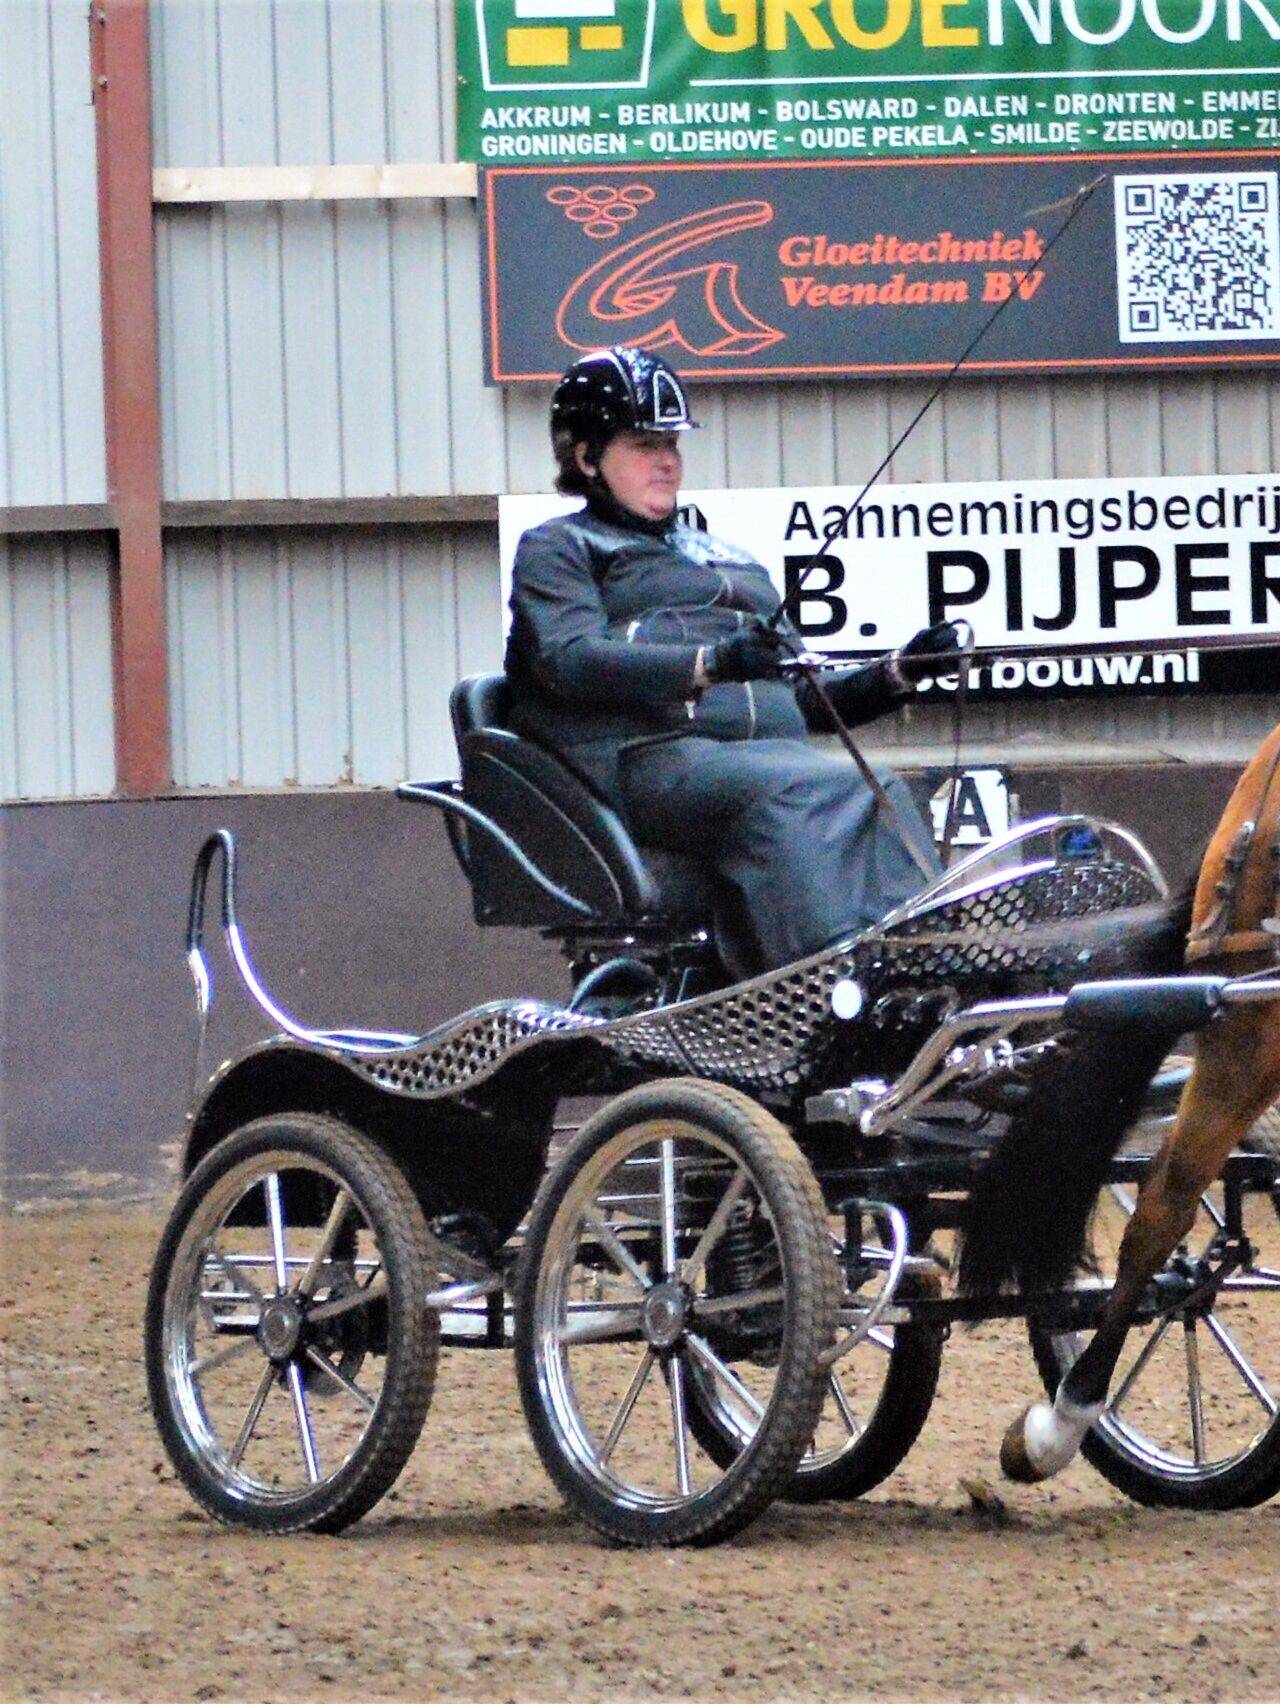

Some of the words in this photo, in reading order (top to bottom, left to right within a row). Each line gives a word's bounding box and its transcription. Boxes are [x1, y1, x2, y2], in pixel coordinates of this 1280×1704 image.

[481, 105, 591, 129] AKKRUM
[618, 102, 750, 126] BERLIKUM
[776, 97, 918, 122] BOLSWARD
[944, 95, 1028, 118] DALEN
[1055, 92, 1175, 115] DRONTEN
[480, 133, 627, 157] GRONINGEN
[650, 129, 778, 153] OLDEHOVE
[801, 127, 866, 149] OUDE
[872, 124, 969, 148] PEKELA
[990, 121, 1080, 144] SMILDE
[1102, 119, 1234, 142] ZEEWOLDE
[779, 228, 1044, 267] Gloeitechniek
[780, 272, 970, 308] Veendam
[981, 269, 1045, 303] BV
[784, 554, 877, 637] B.
[943, 776, 992, 837] A
